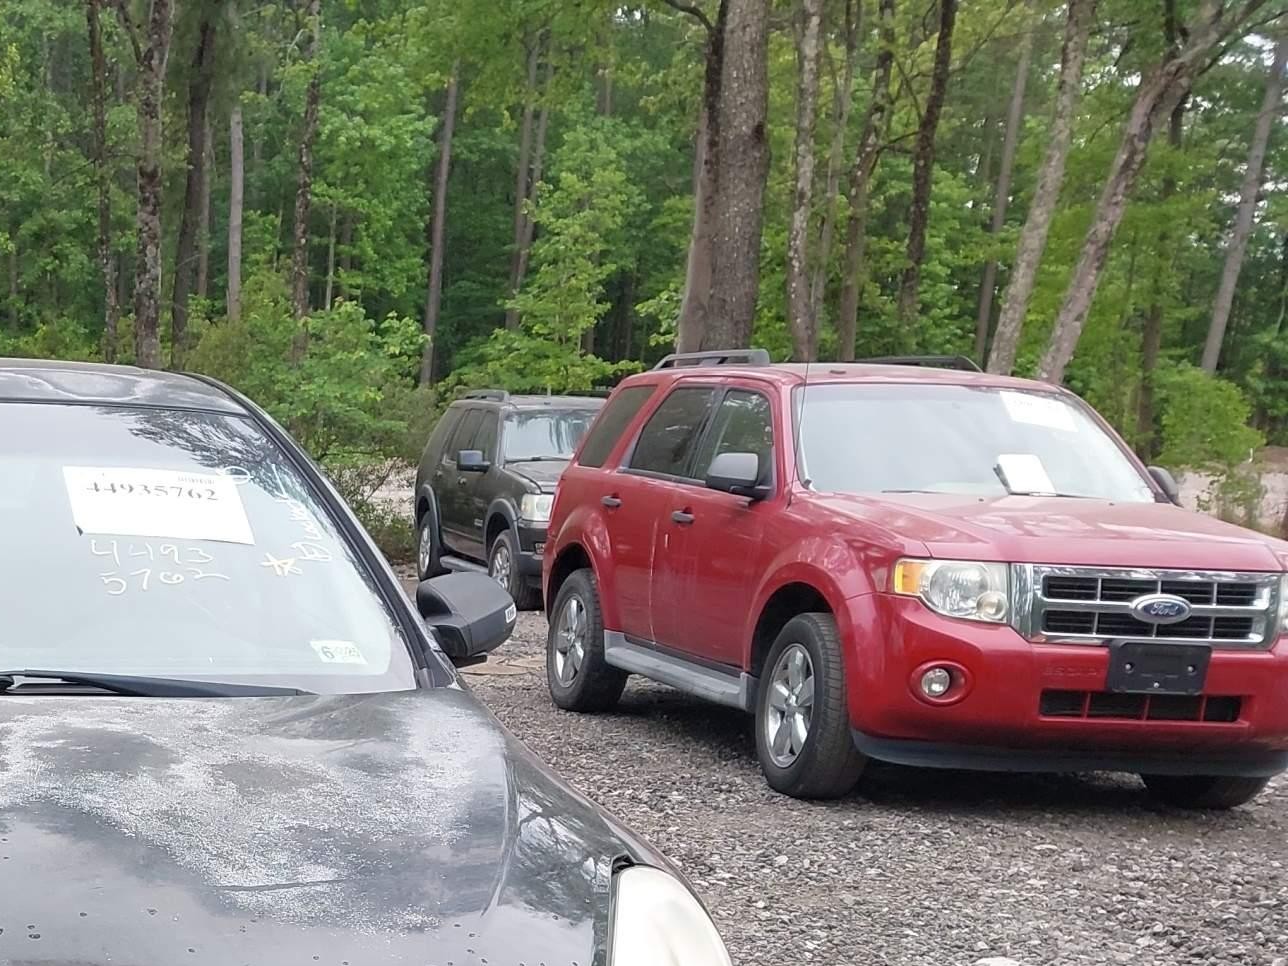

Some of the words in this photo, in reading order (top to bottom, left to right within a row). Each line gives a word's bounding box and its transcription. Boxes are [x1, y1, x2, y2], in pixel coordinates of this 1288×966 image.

[86, 481, 219, 501] 44935762
[90, 539, 214, 567] 4493
[99, 567, 230, 595] 5762
[1150, 602, 1179, 616] Ford
